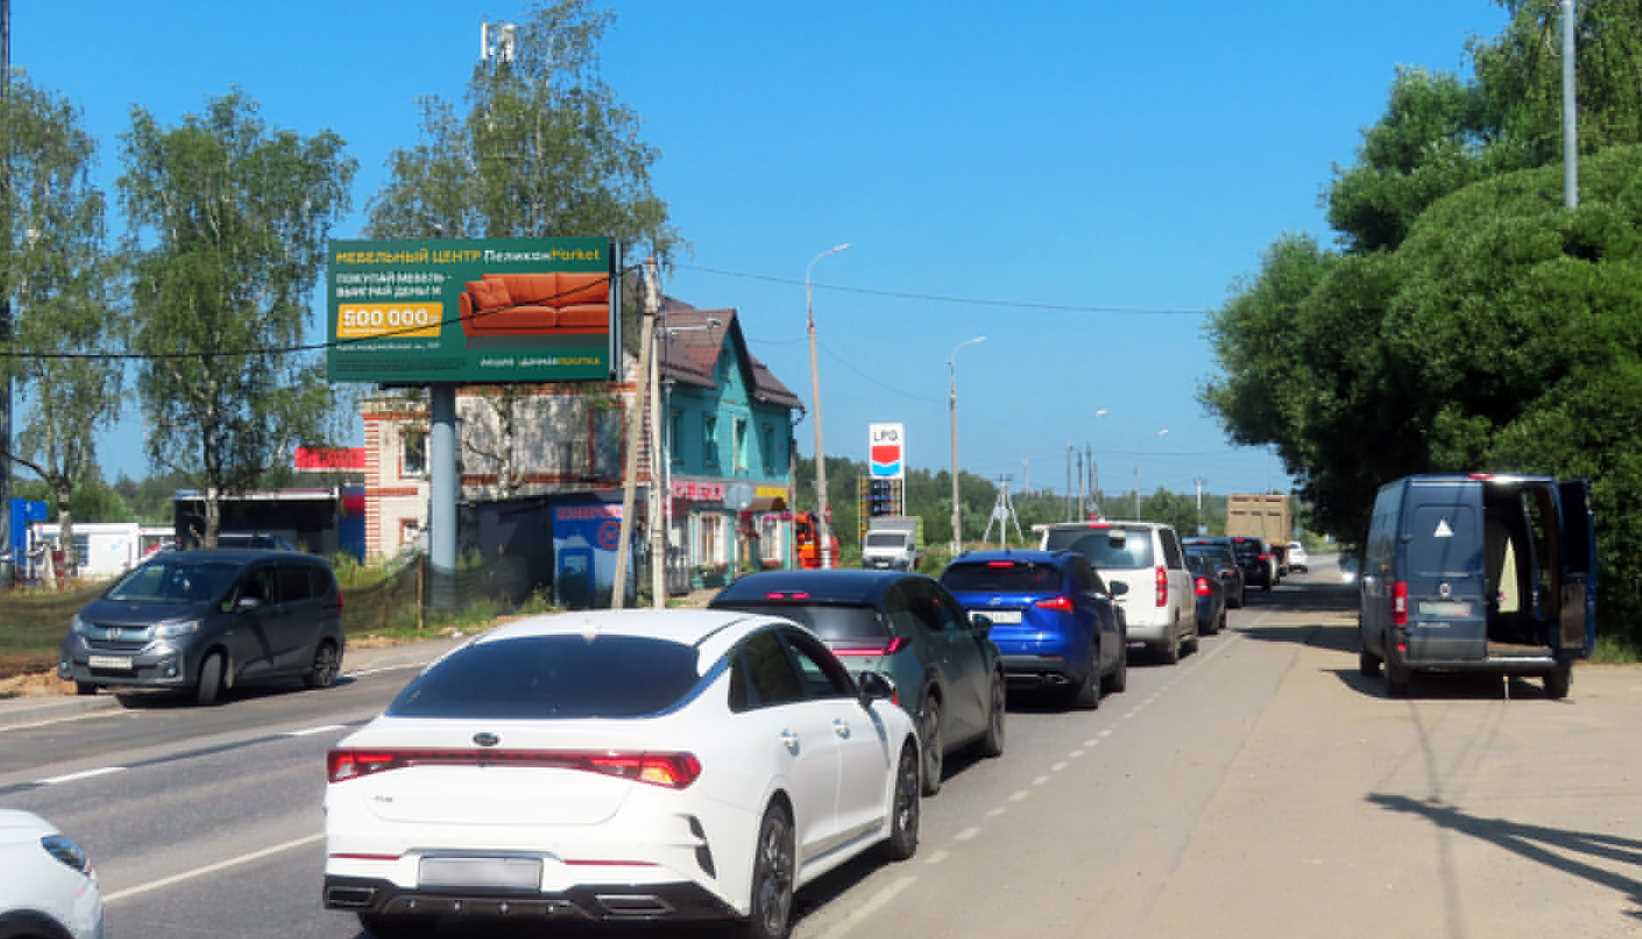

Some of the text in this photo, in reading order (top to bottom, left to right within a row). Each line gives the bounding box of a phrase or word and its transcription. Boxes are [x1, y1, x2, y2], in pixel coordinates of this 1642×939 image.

[336, 248, 428, 265] МЕБЕЛЬНЫЙ
[432, 249, 481, 264] ЦЕНТР
[336, 273, 394, 285] ПОКУПАЙ
[395, 272, 444, 284] МЕБЕЛЬ
[343, 309, 430, 327] 500 000
